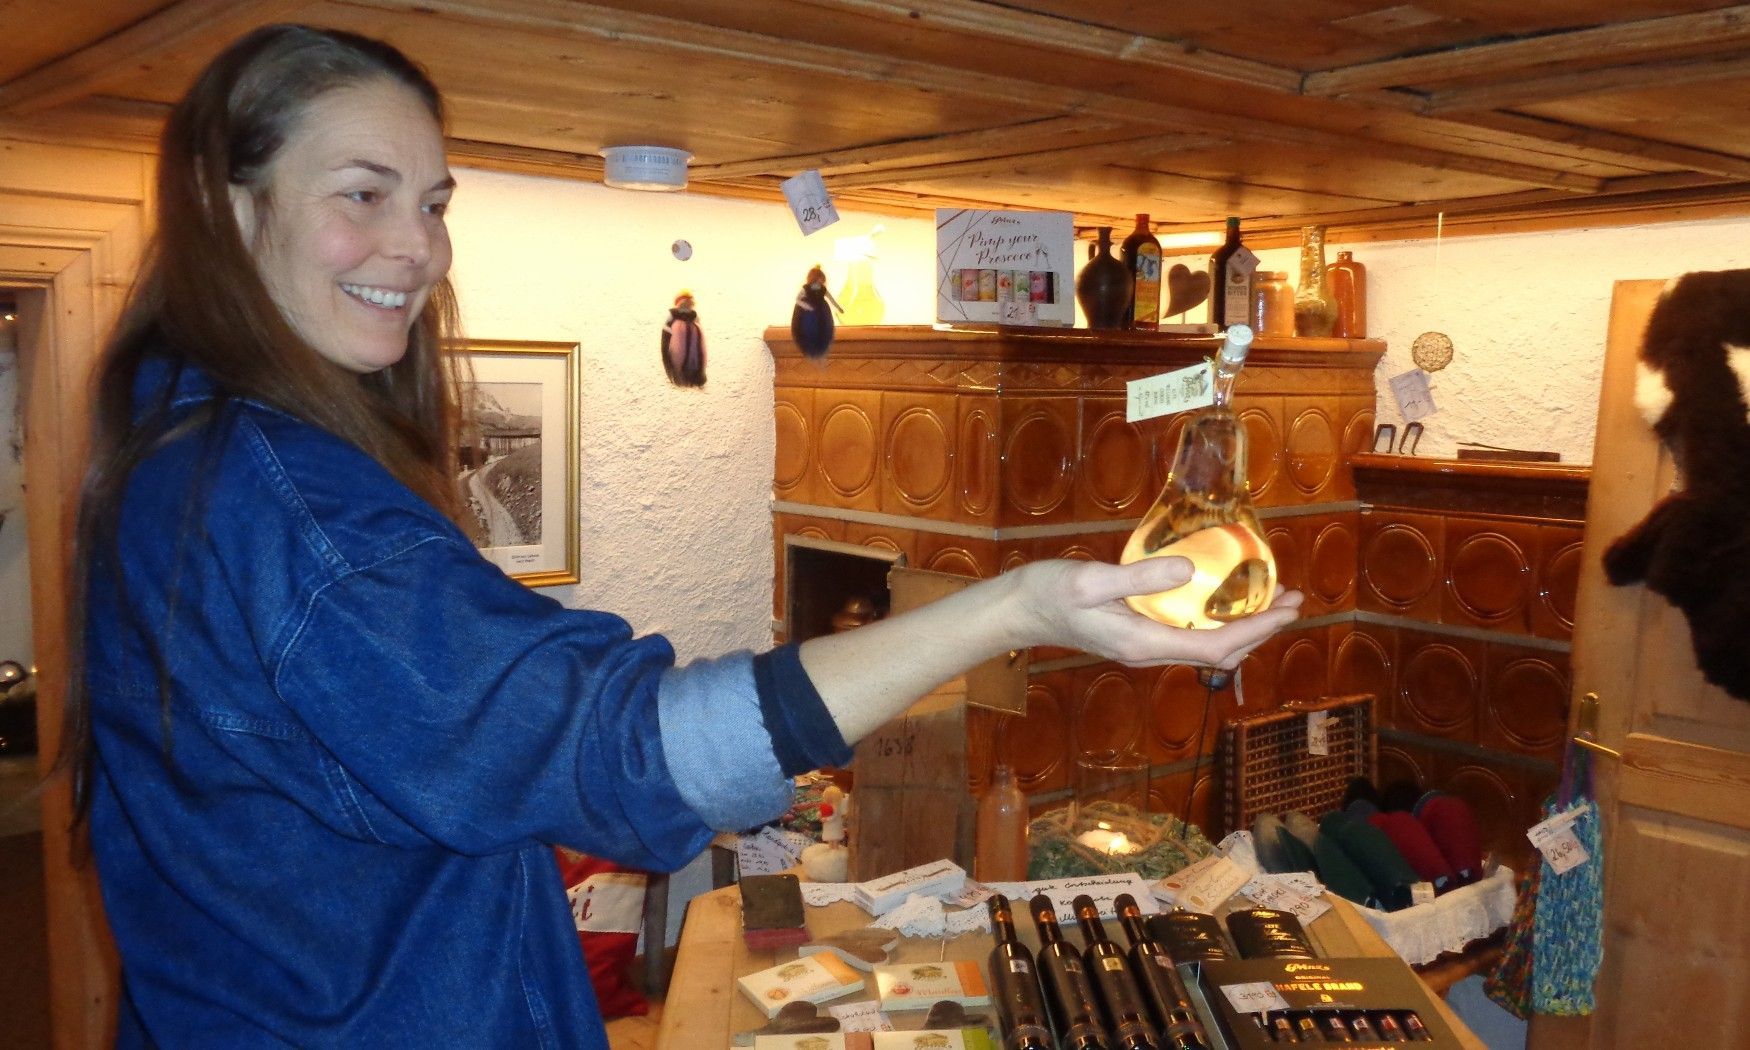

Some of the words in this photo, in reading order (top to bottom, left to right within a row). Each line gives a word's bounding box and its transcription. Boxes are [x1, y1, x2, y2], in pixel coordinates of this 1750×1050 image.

[968, 230, 1004, 250] Pimp
[1008, 233, 1039, 249] your
[975, 248, 1032, 264] Prosecco
[1322, 982, 1363, 991] BRAND
